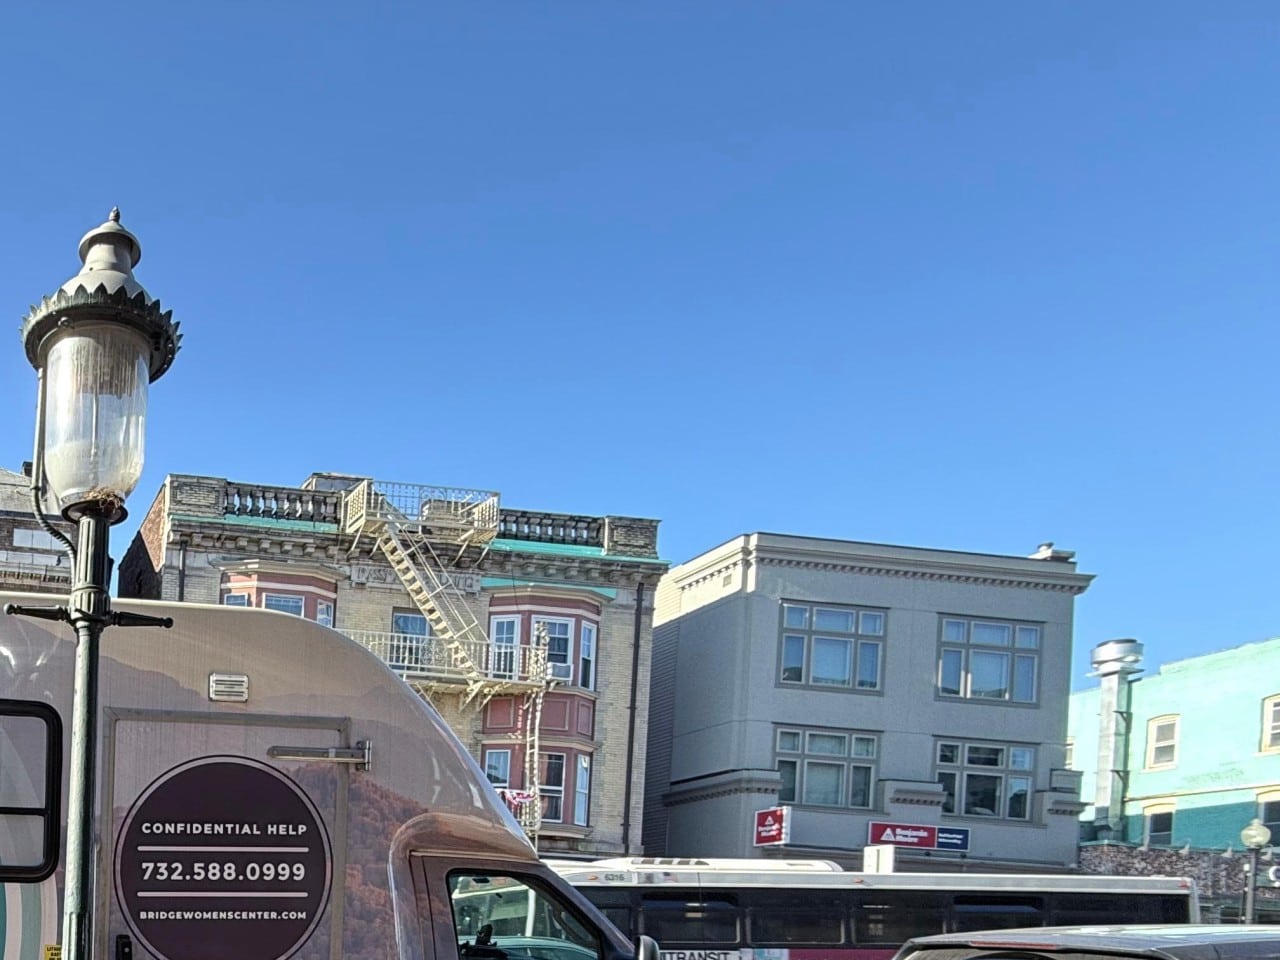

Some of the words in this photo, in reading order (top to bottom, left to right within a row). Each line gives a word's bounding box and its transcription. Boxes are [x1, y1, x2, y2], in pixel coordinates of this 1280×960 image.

[141, 822, 261, 835] CONFIDENTIAL
[267, 824, 307, 835] HELP
[141, 862, 306, 881] 732.588.0999
[139, 911, 307, 920] BRIDGEWOMENSCENTER.COM
